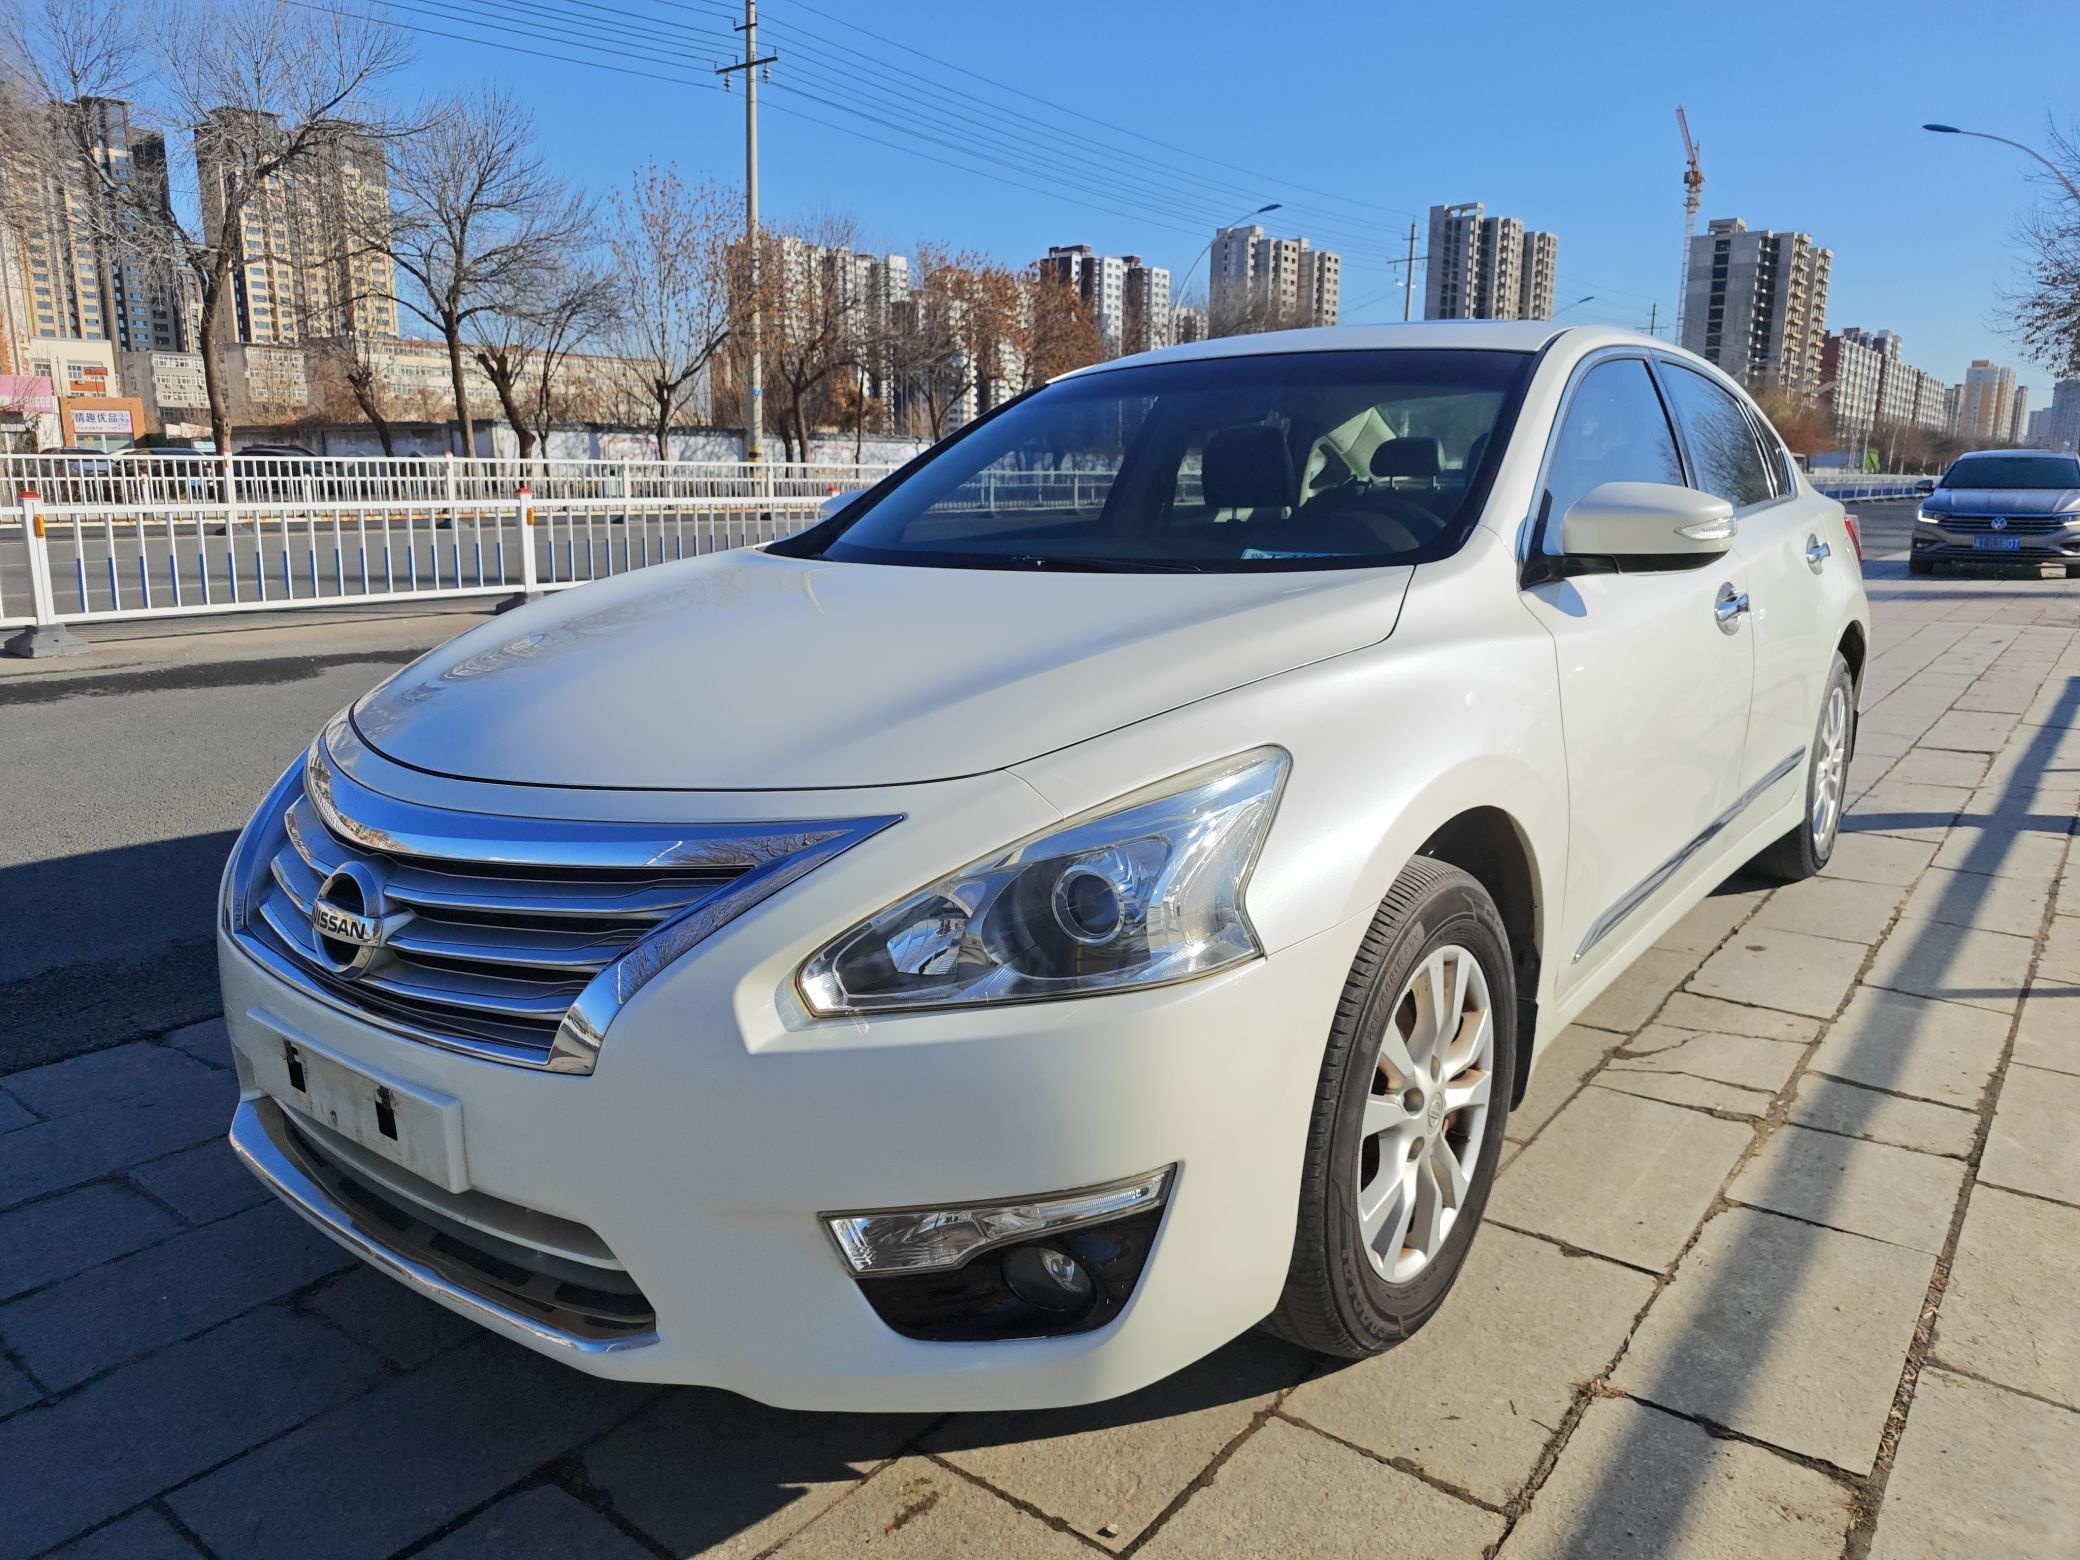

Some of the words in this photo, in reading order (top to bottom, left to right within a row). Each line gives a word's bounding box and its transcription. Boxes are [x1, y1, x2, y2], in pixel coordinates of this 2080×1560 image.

[75, 412, 118, 424] 情趣优品
[312, 906, 366, 940] NISSAN
